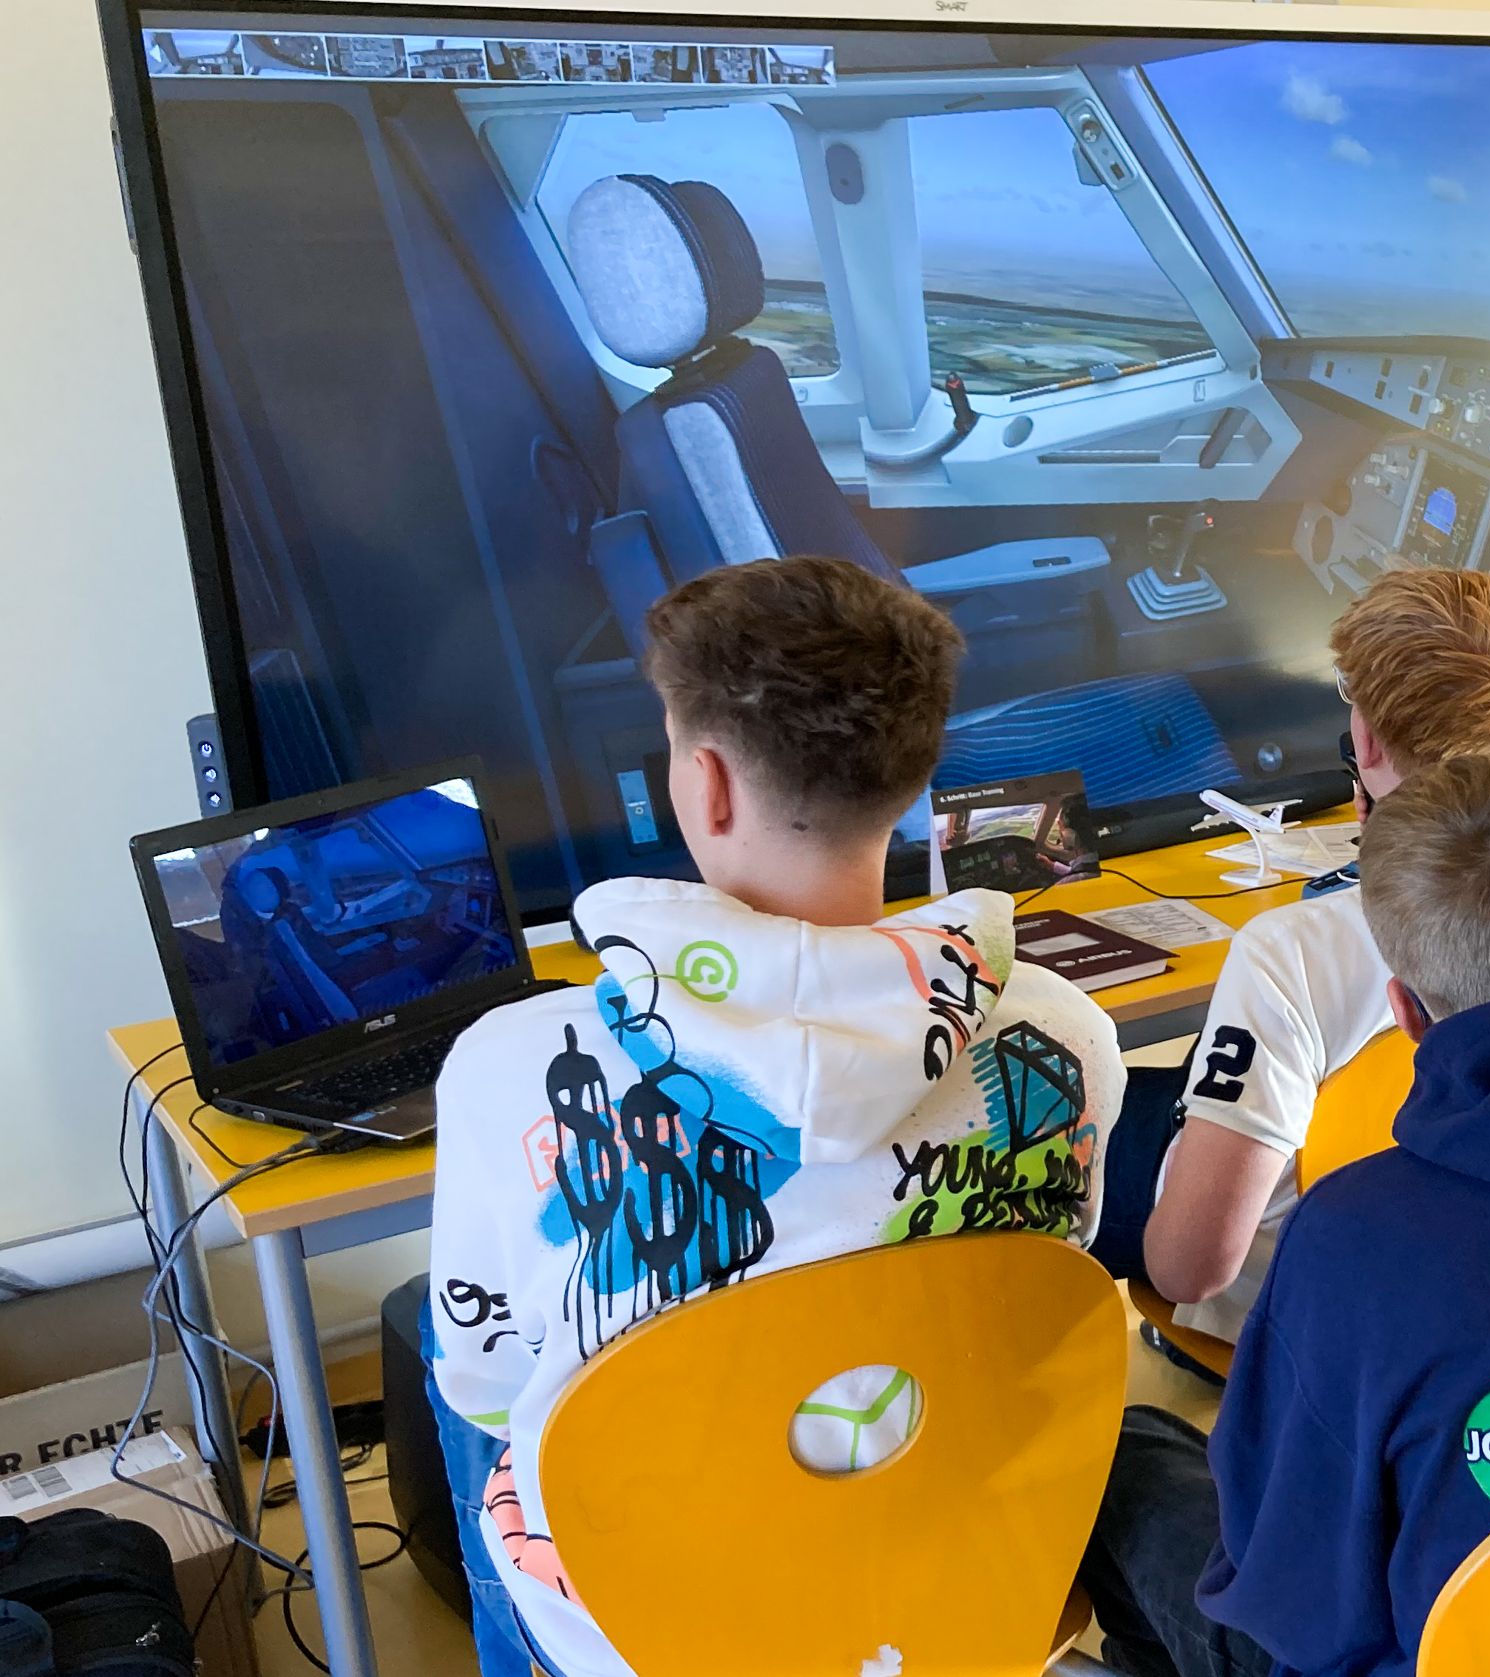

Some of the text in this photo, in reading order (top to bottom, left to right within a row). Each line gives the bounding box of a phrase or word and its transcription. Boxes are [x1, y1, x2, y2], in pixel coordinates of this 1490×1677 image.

[936, 1, 968, 12] SMART
[1078, 949, 1133, 964] AIRBUS
[364, 1014, 396, 1034] ASUS
[1192, 1024, 1257, 1103] 2
